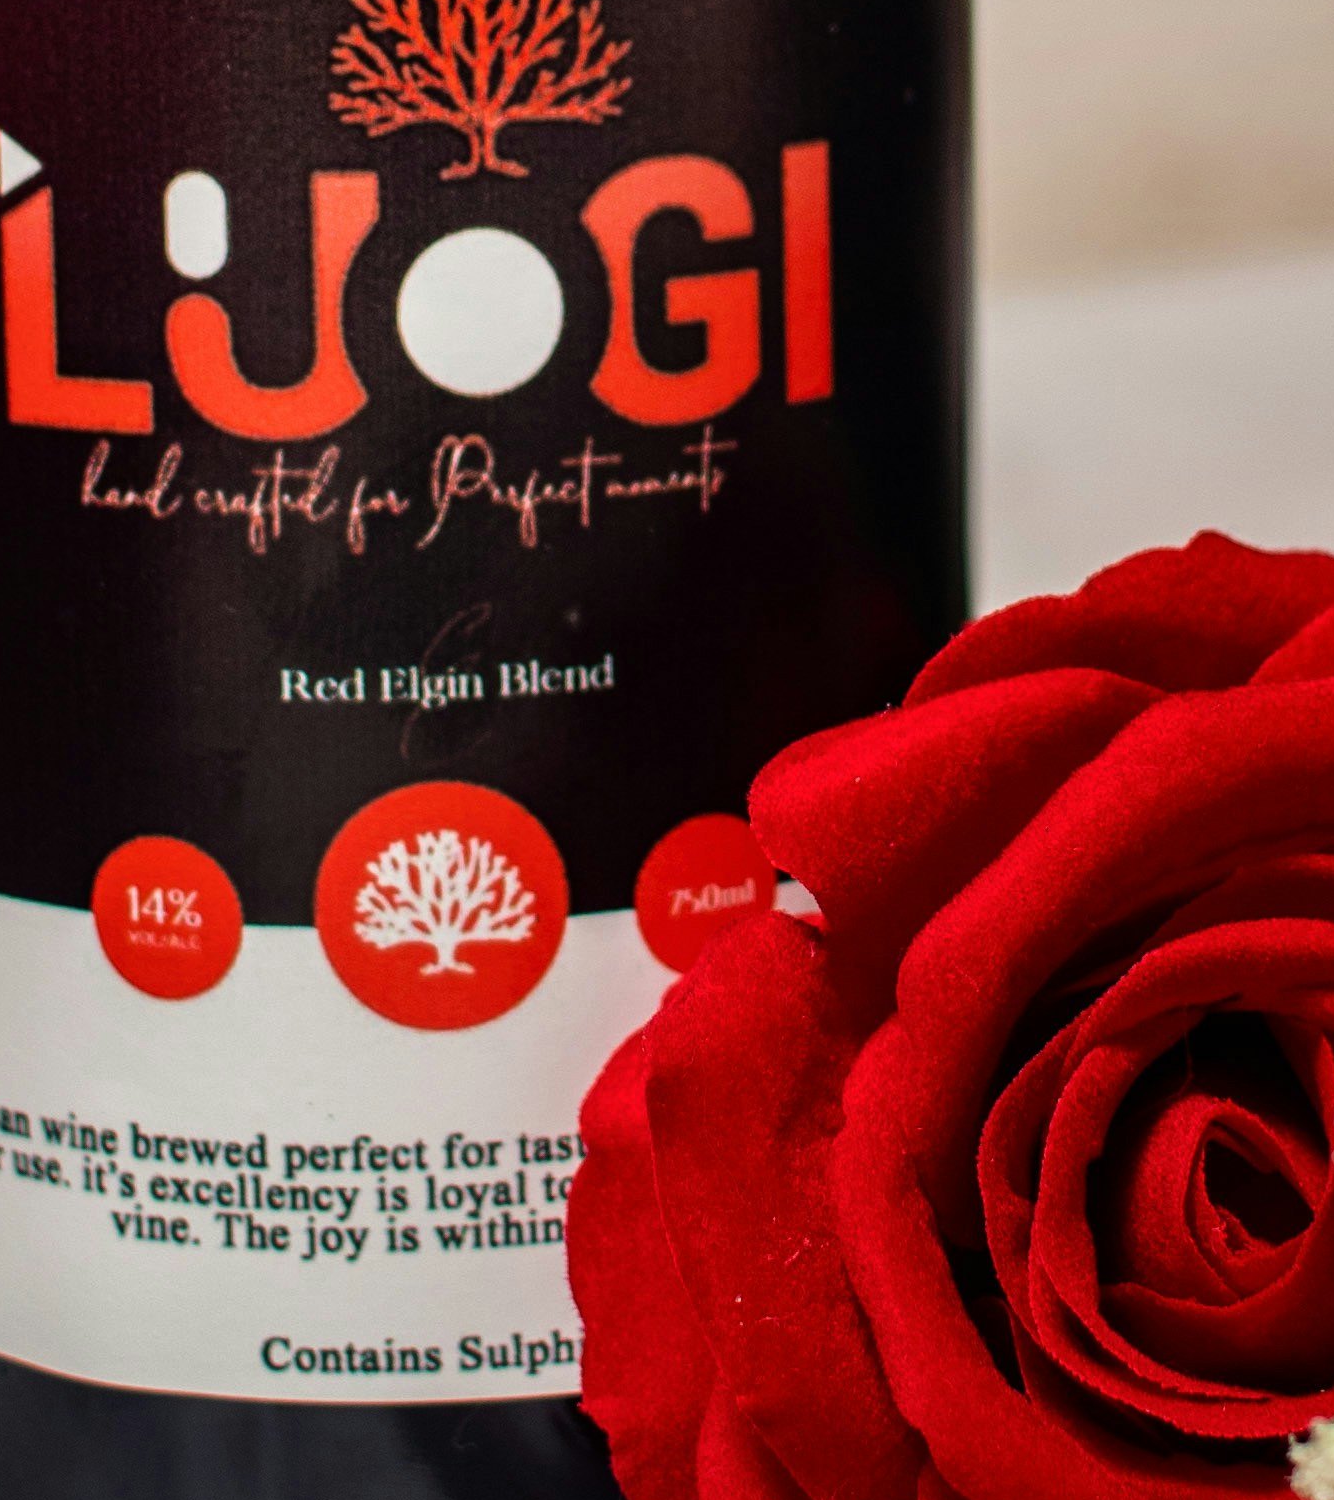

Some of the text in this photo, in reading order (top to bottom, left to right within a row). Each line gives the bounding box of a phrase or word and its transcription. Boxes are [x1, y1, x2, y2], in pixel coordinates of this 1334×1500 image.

[81, 438, 183, 519] hand
[347, 477, 410, 556] for
[280, 652, 614, 709] Red Elgin Blend
[128, 885, 202, 928] 14%
[40, 1111, 117, 1156] wine
[130, 1122, 267, 1168] brewed
[283, 1135, 428, 1180] perfect
[443, 1132, 503, 1170] for
[12, 1150, 71, 1188] use.
[149, 1169, 359, 1222] excellency
[376, 1176, 409, 1212] is
[426, 1171, 526, 1219] loyal
[111, 1205, 565, 1263] vine. The joy is within
[261, 1336, 441, 1374] Contains
